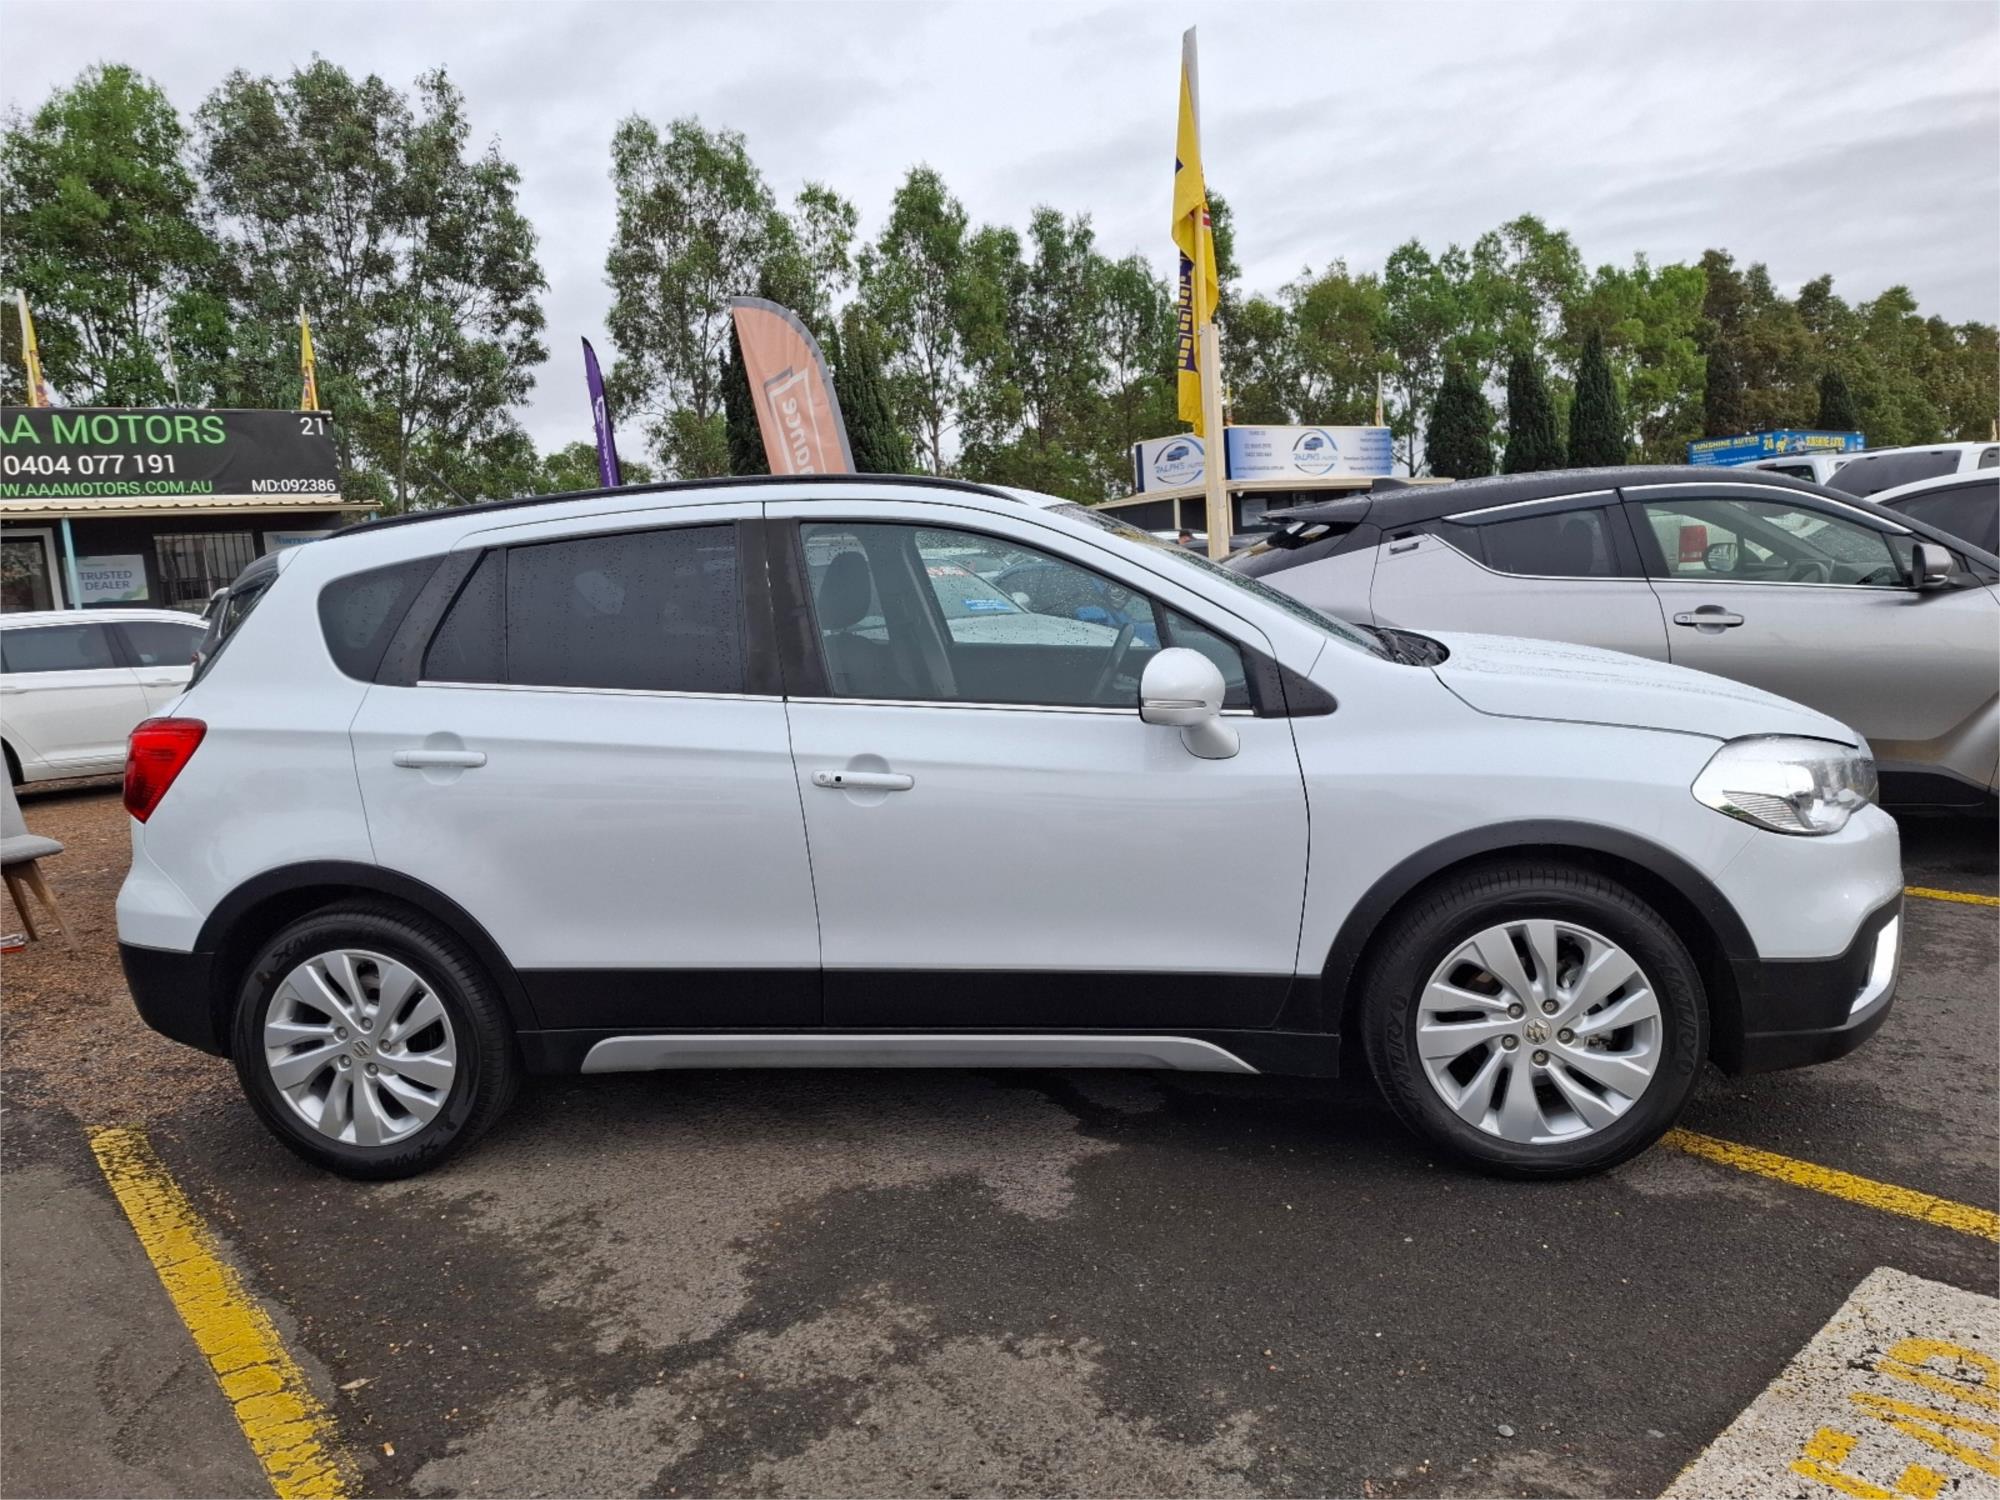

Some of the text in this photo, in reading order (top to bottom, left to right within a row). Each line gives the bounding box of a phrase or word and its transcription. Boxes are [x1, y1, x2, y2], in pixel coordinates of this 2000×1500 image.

[52, 414, 226, 445] MOTORS
[300, 416, 324, 436] 21
[3, 454, 175, 475] 0404 077 191
[0, 480, 213, 497] W.AAAMOTORS.COM.AU
[252, 479, 336, 493] MD:092386
[79, 570, 133, 581] TRUSTED
[84, 580, 131, 591] DEALER
